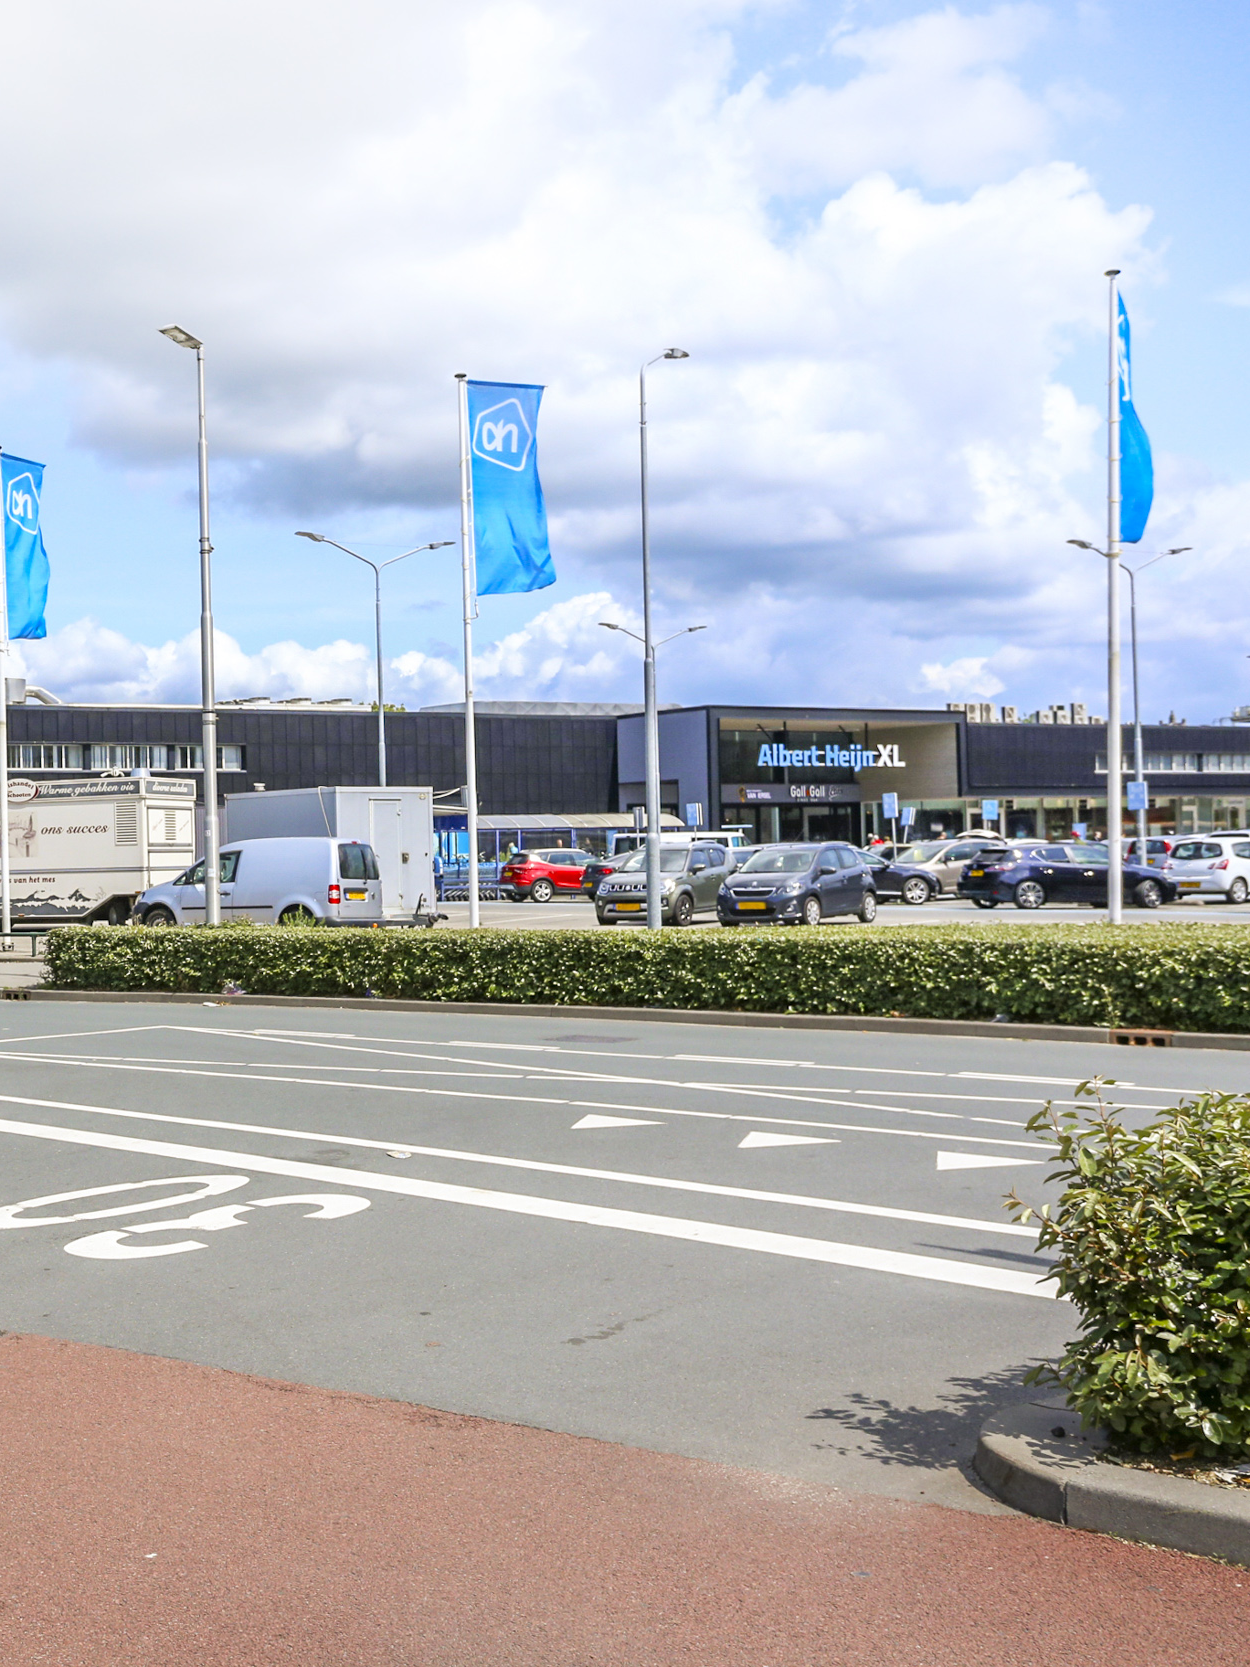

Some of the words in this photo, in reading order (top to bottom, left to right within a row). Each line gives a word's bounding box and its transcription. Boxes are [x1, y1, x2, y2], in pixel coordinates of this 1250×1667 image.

[757, 743, 820, 767] Albert
[825, 744, 874, 772] Heijn
[876, 744, 906, 768] XL
[7, 781, 34, 790] ishandel
[39, 784, 73, 796] Warme
[71, 783, 119, 797] gebakken
[120, 782, 136, 791] vis
[790, 785, 806, 798] Gall
[809, 785, 825, 798] Gall
[40, 826, 63, 835] ons
[66, 824, 110, 834] succes
[29, 876, 40, 884] het
